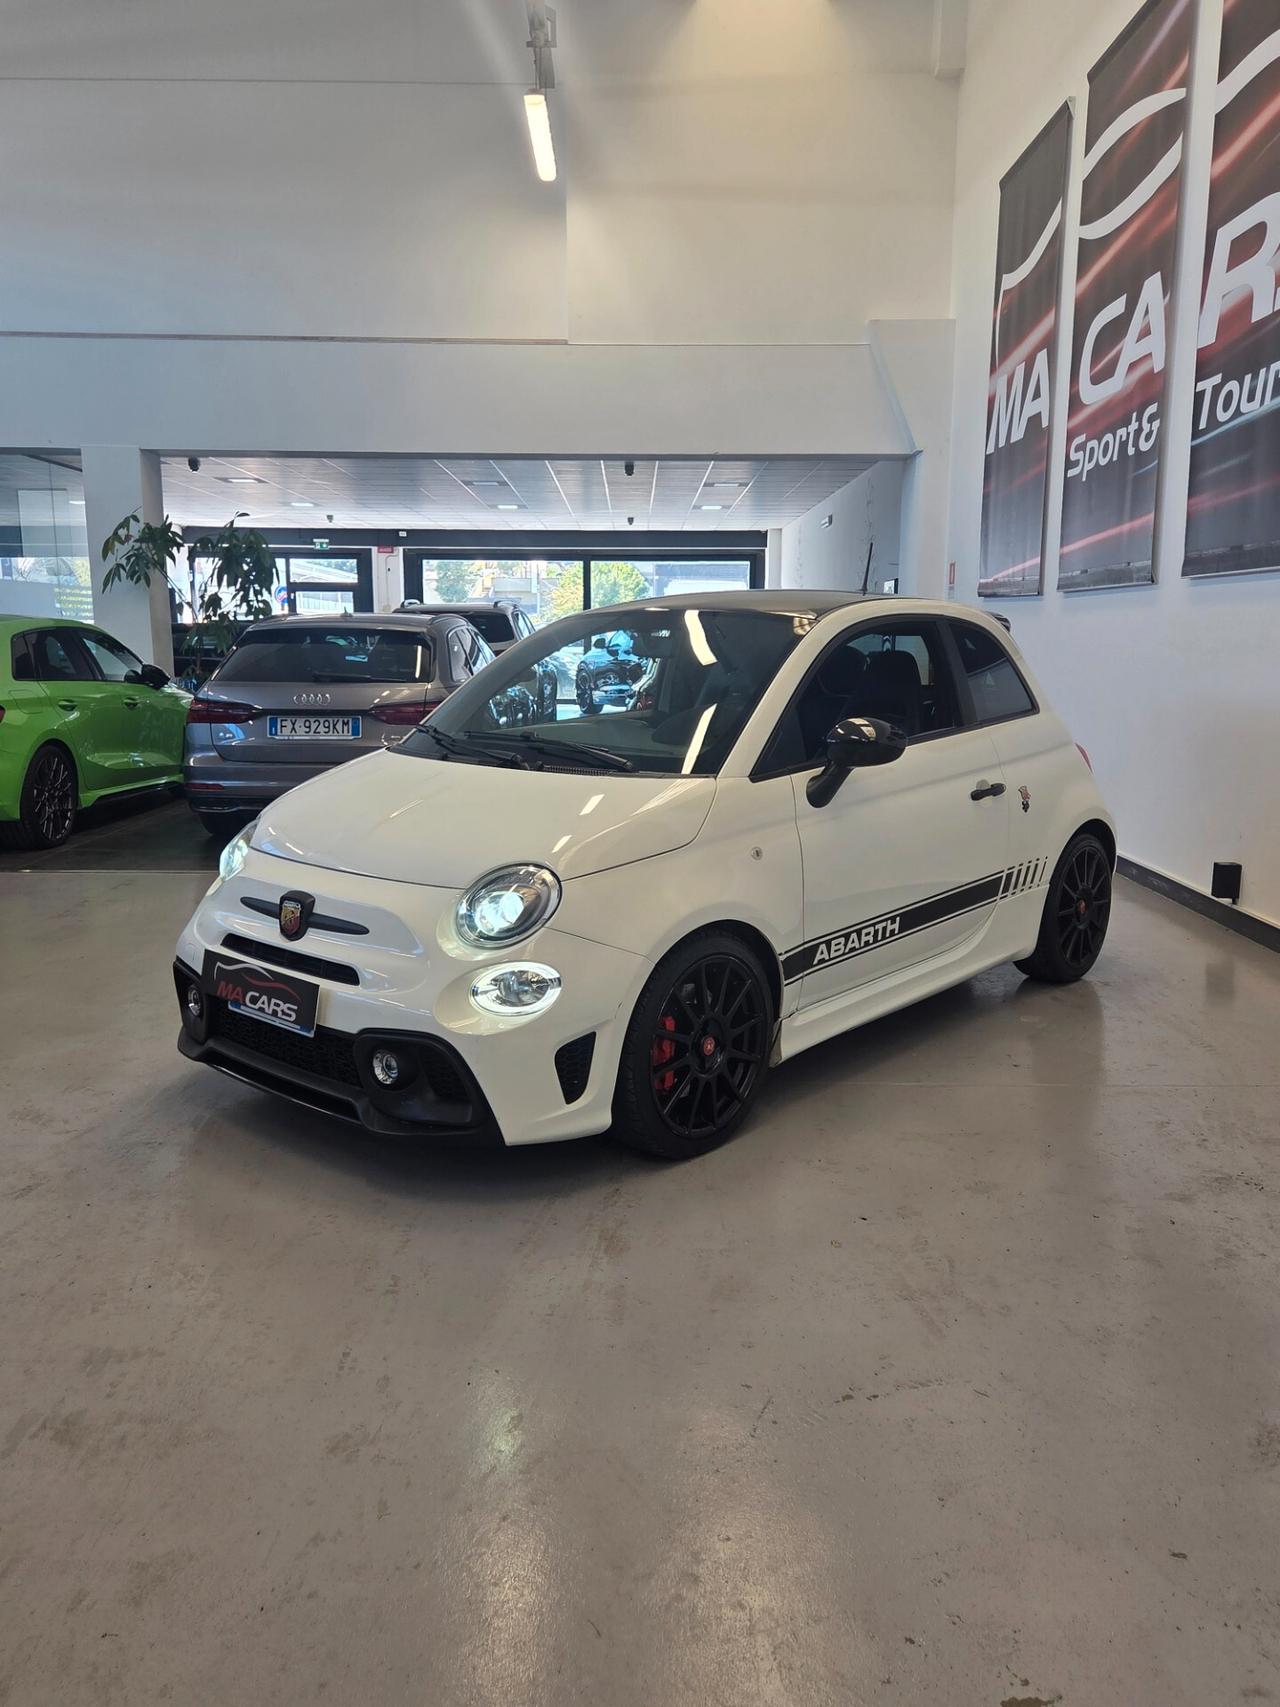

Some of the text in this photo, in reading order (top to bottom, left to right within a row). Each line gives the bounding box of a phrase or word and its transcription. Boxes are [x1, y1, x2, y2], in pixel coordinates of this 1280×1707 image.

[986, 348, 1050, 455] MA
[1197, 191, 1280, 350] R
[813, 916, 900, 965] ABARTH
